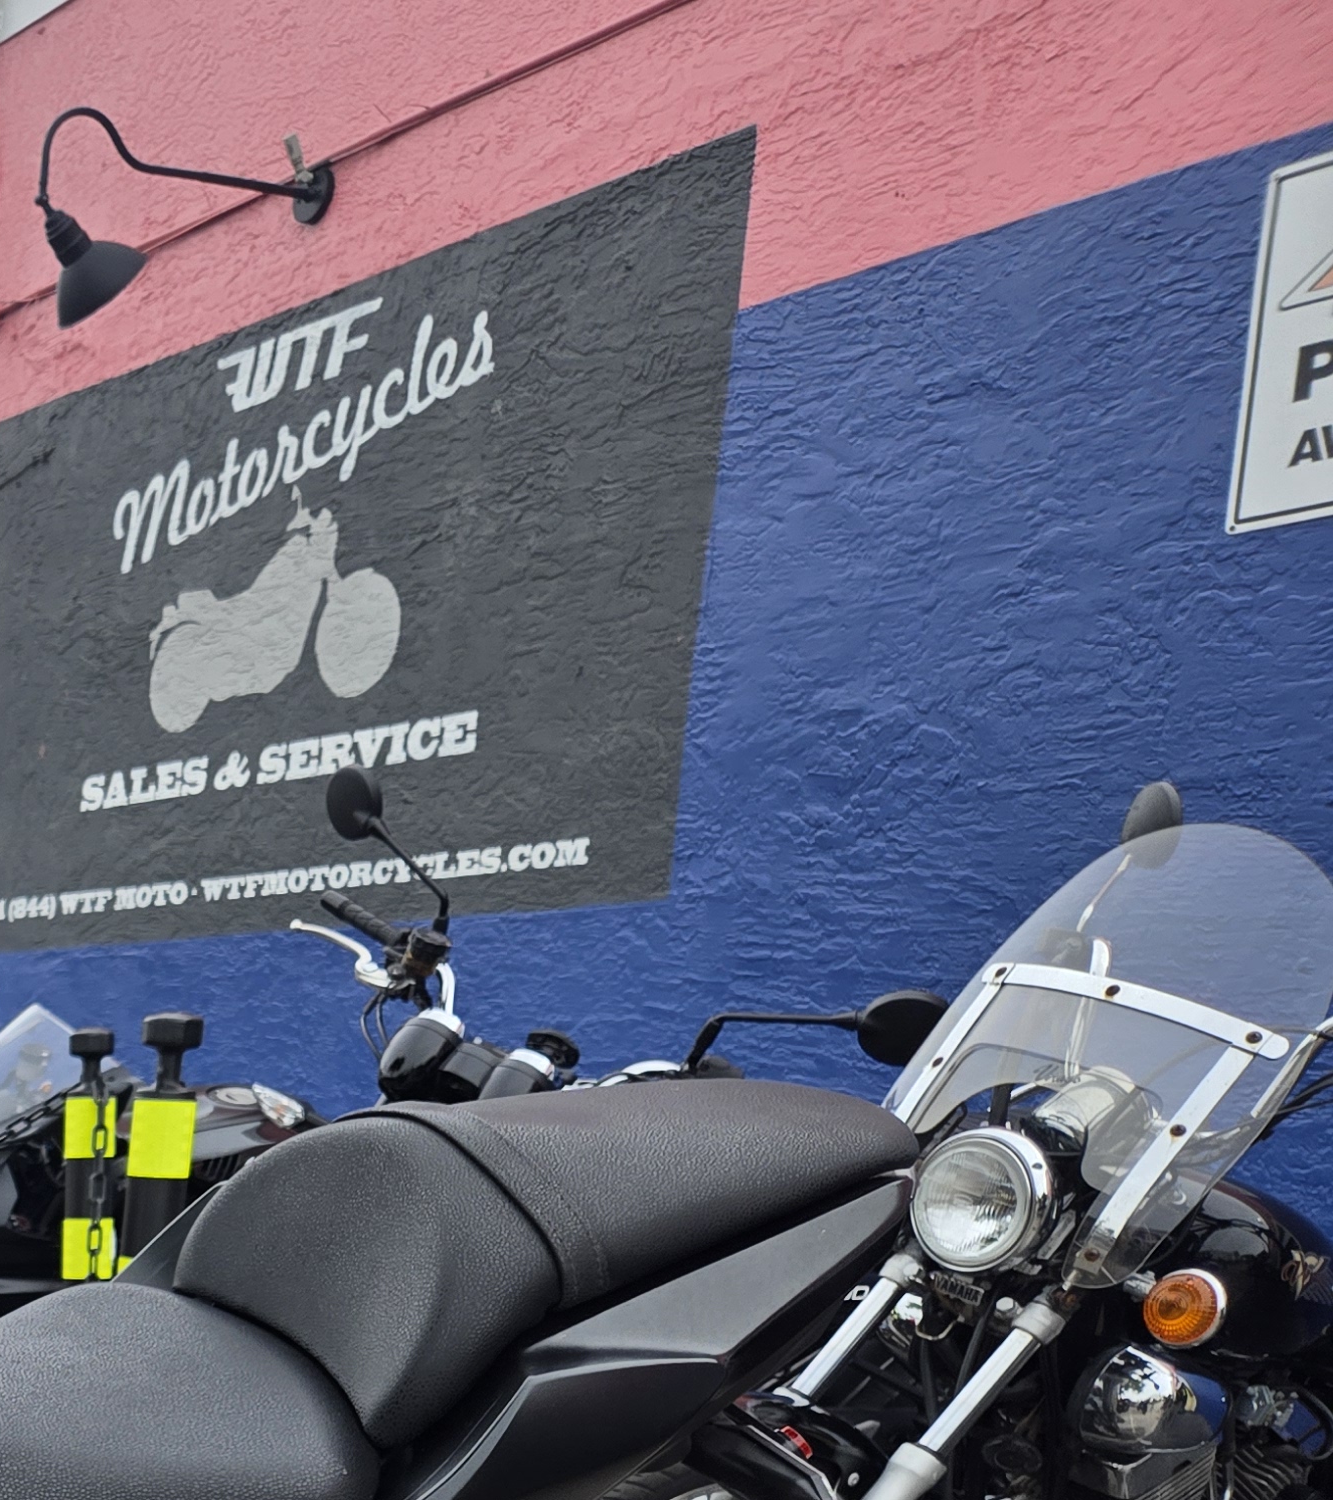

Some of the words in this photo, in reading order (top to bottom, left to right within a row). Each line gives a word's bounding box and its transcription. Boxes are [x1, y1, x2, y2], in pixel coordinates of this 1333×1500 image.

[218, 297, 383, 412] WTF
[114, 310, 495, 574] Motorcycles
[80, 755, 208, 812] SALES
[214, 752, 250, 791] &
[257, 711, 479, 786] SERVICE
[58, 888, 112, 916] WTF
[113, 880, 189, 911] MOTO
[935, 1273, 982, 1304] YAMAHA
